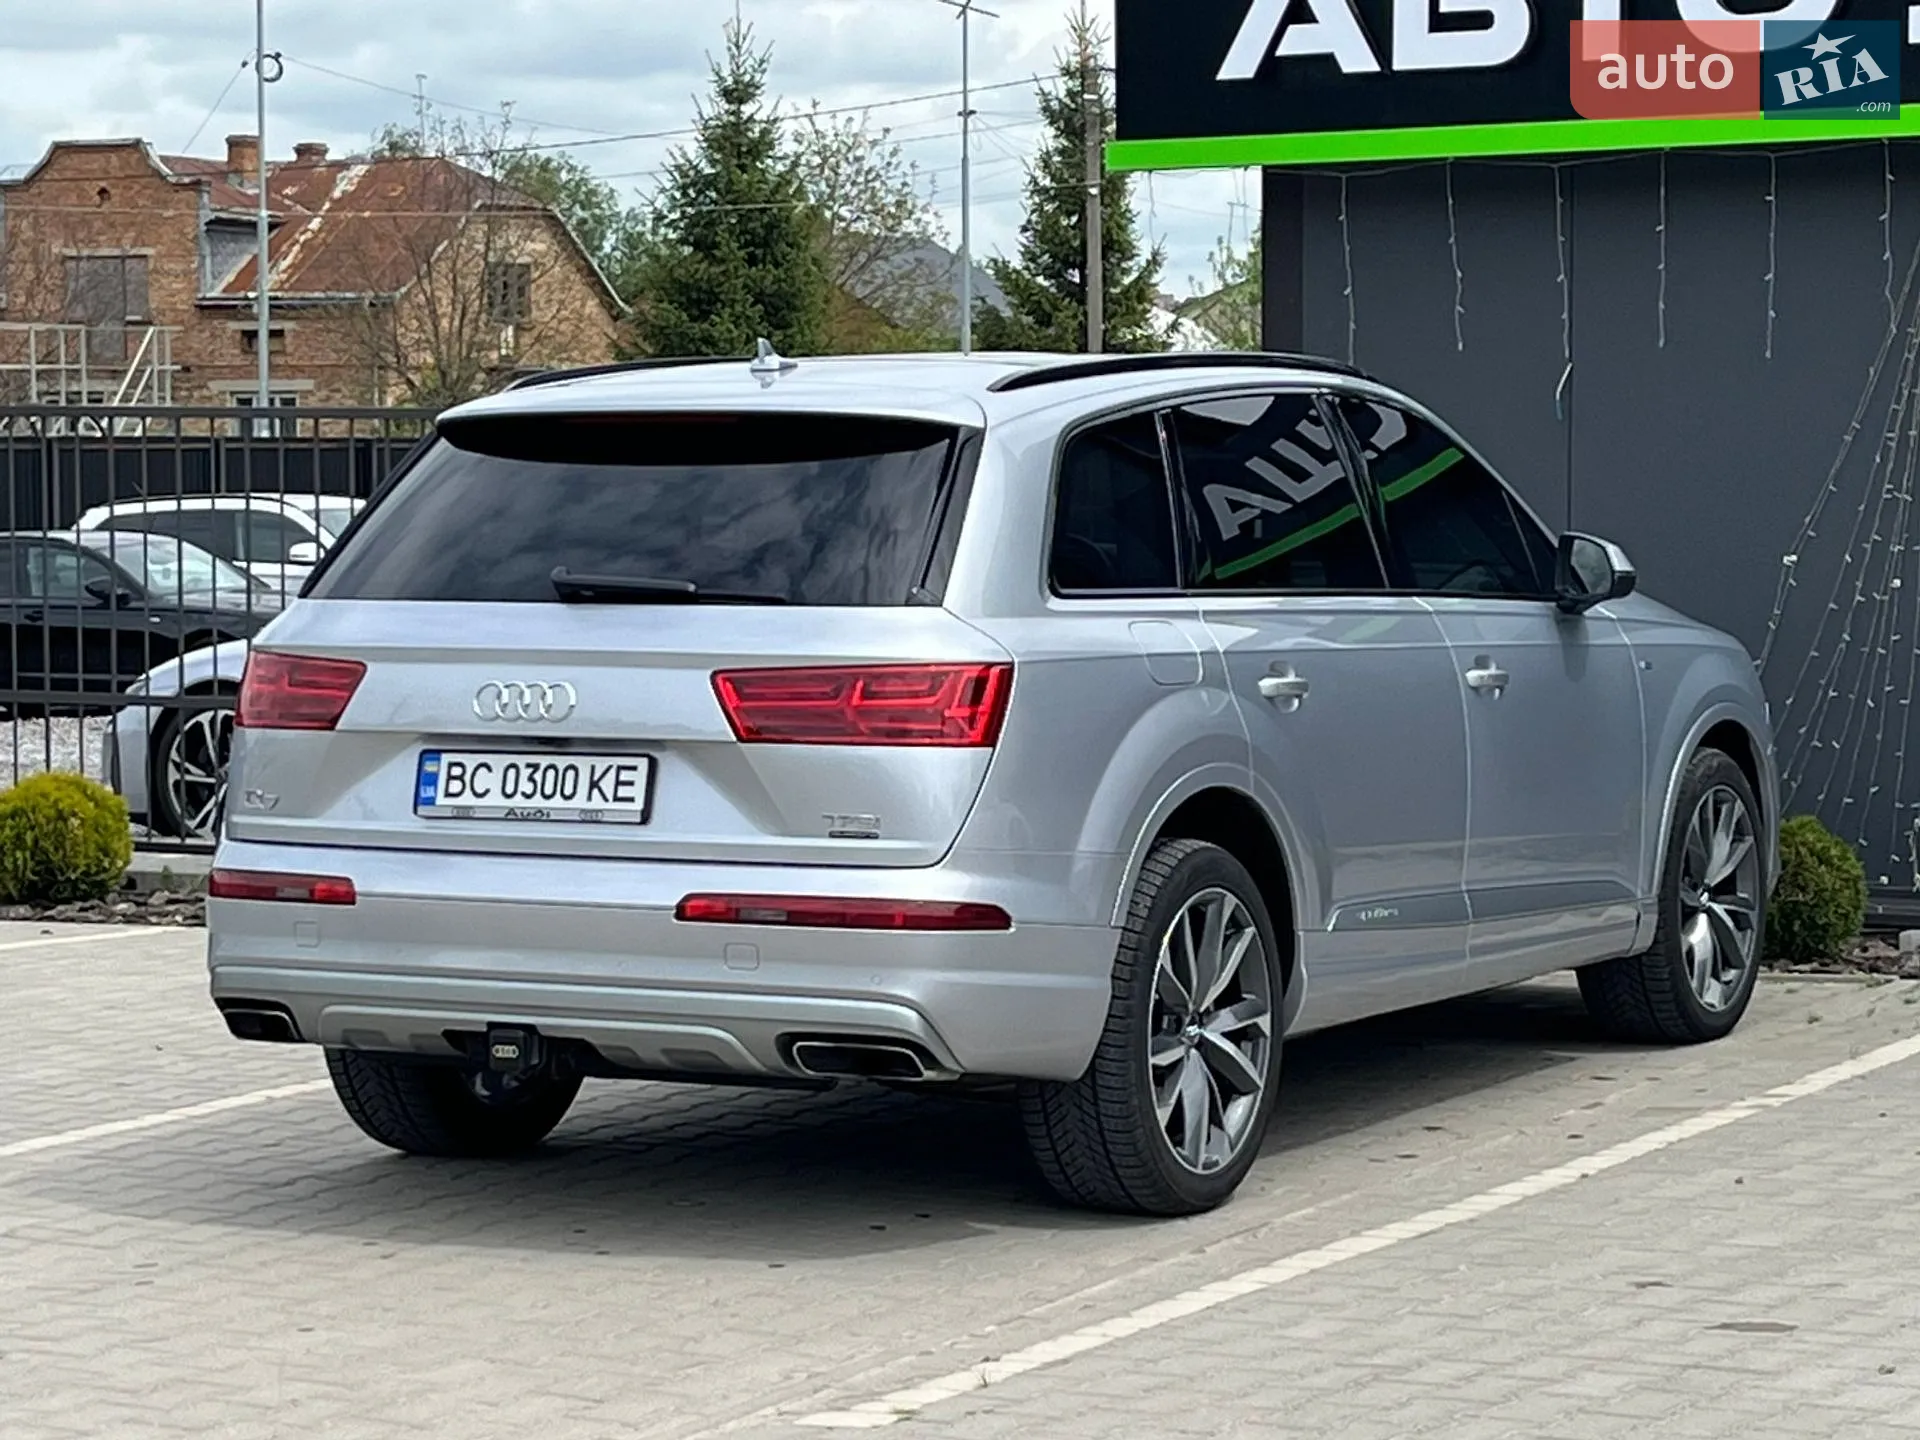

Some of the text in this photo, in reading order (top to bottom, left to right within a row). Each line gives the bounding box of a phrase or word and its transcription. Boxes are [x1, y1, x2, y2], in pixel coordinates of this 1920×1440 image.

[443, 761, 639, 803] BC 0300 KE
[503, 809, 551, 820] Audi
